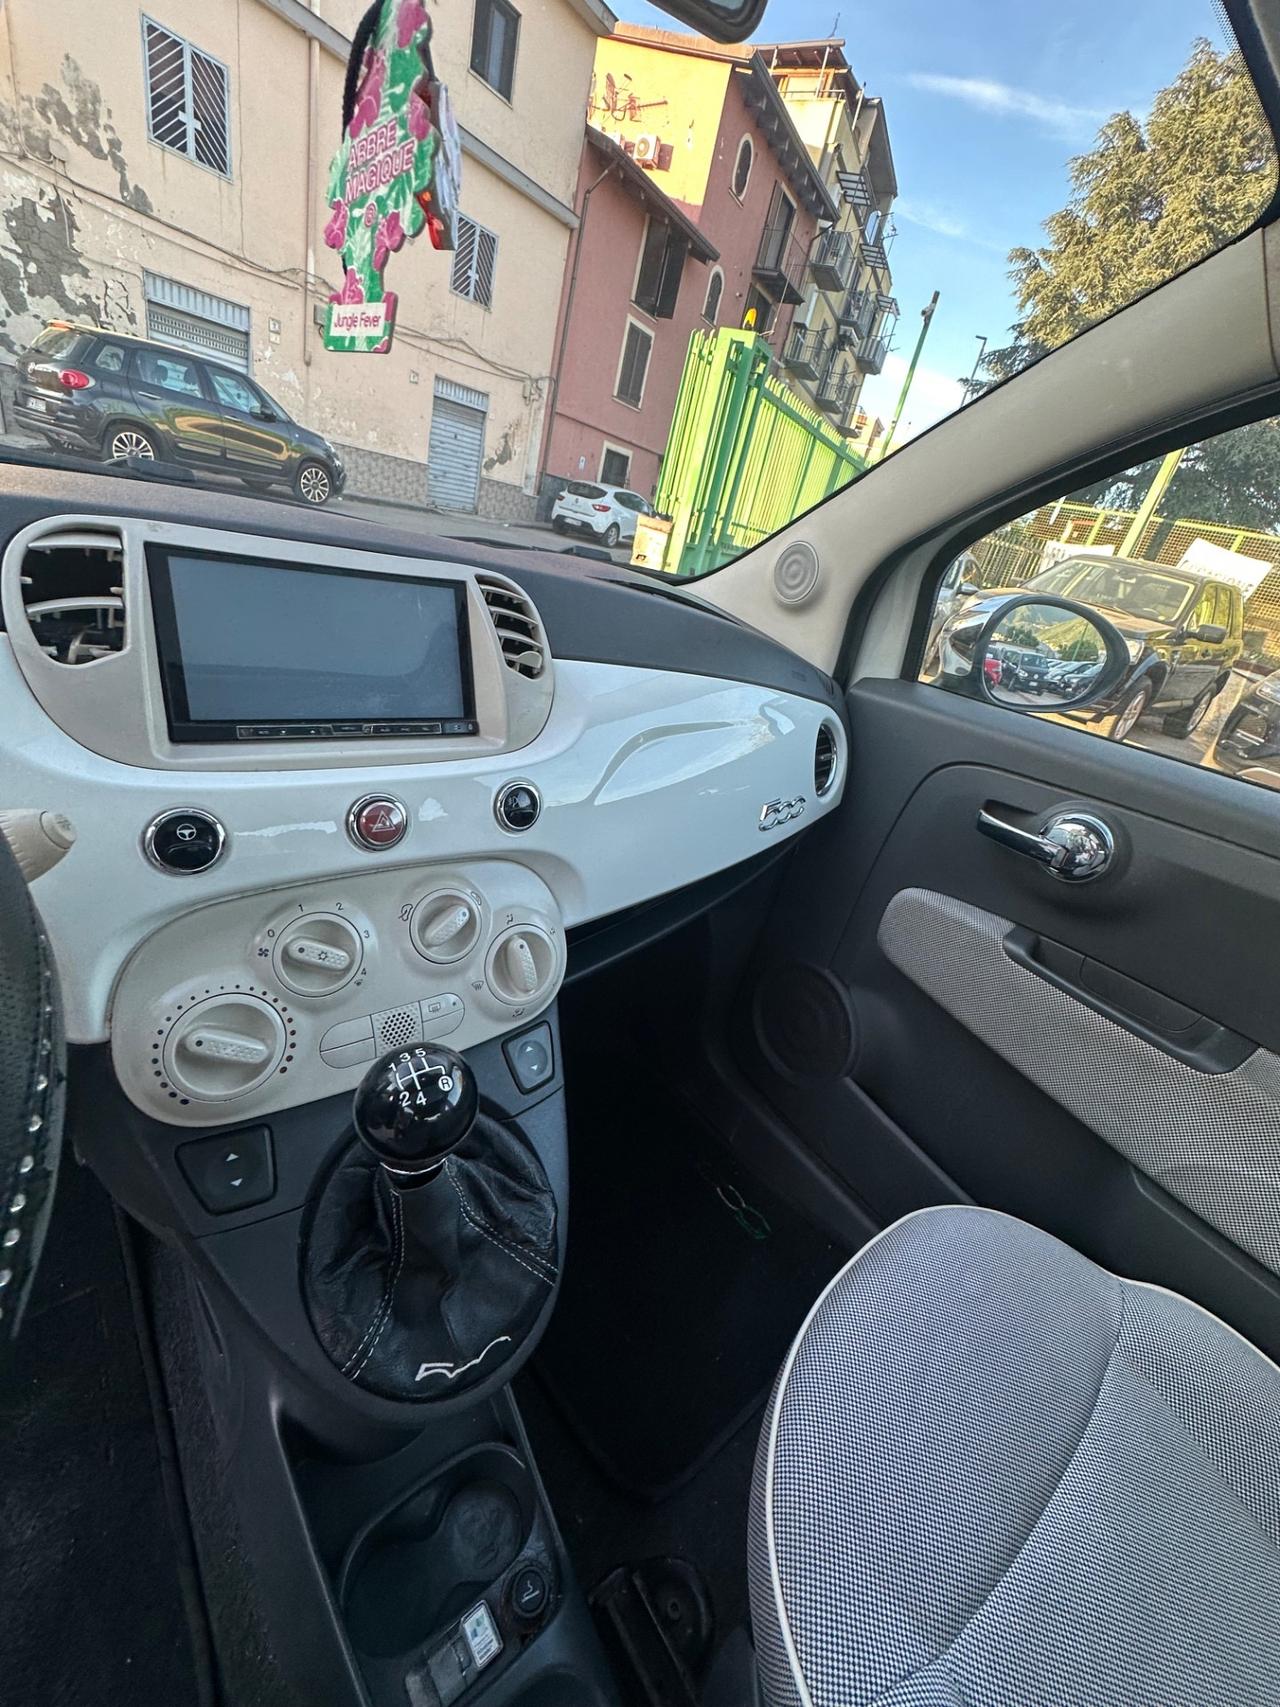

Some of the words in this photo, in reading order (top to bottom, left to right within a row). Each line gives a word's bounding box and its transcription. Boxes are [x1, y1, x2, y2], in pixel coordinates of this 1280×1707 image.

[348, 116, 398, 173] ARBRE
[345, 139, 416, 206] MAGIQUE
[334, 312, 358, 331] Jungle
[359, 311, 382, 328] Fever
[759, 796, 806, 831] 500
[298, 903, 304, 913] 1
[335, 902, 344, 911] 2
[267, 928, 275, 938] 0
[363, 929, 370, 939] 3
[360, 967, 367, 976] 4
[399, 1052, 411, 1063] 3
[415, 1047, 427, 1057] 5
[440, 1077, 452, 1090] R
[399, 1091, 412, 1108] 2
[416, 1090, 427, 1106] 4
